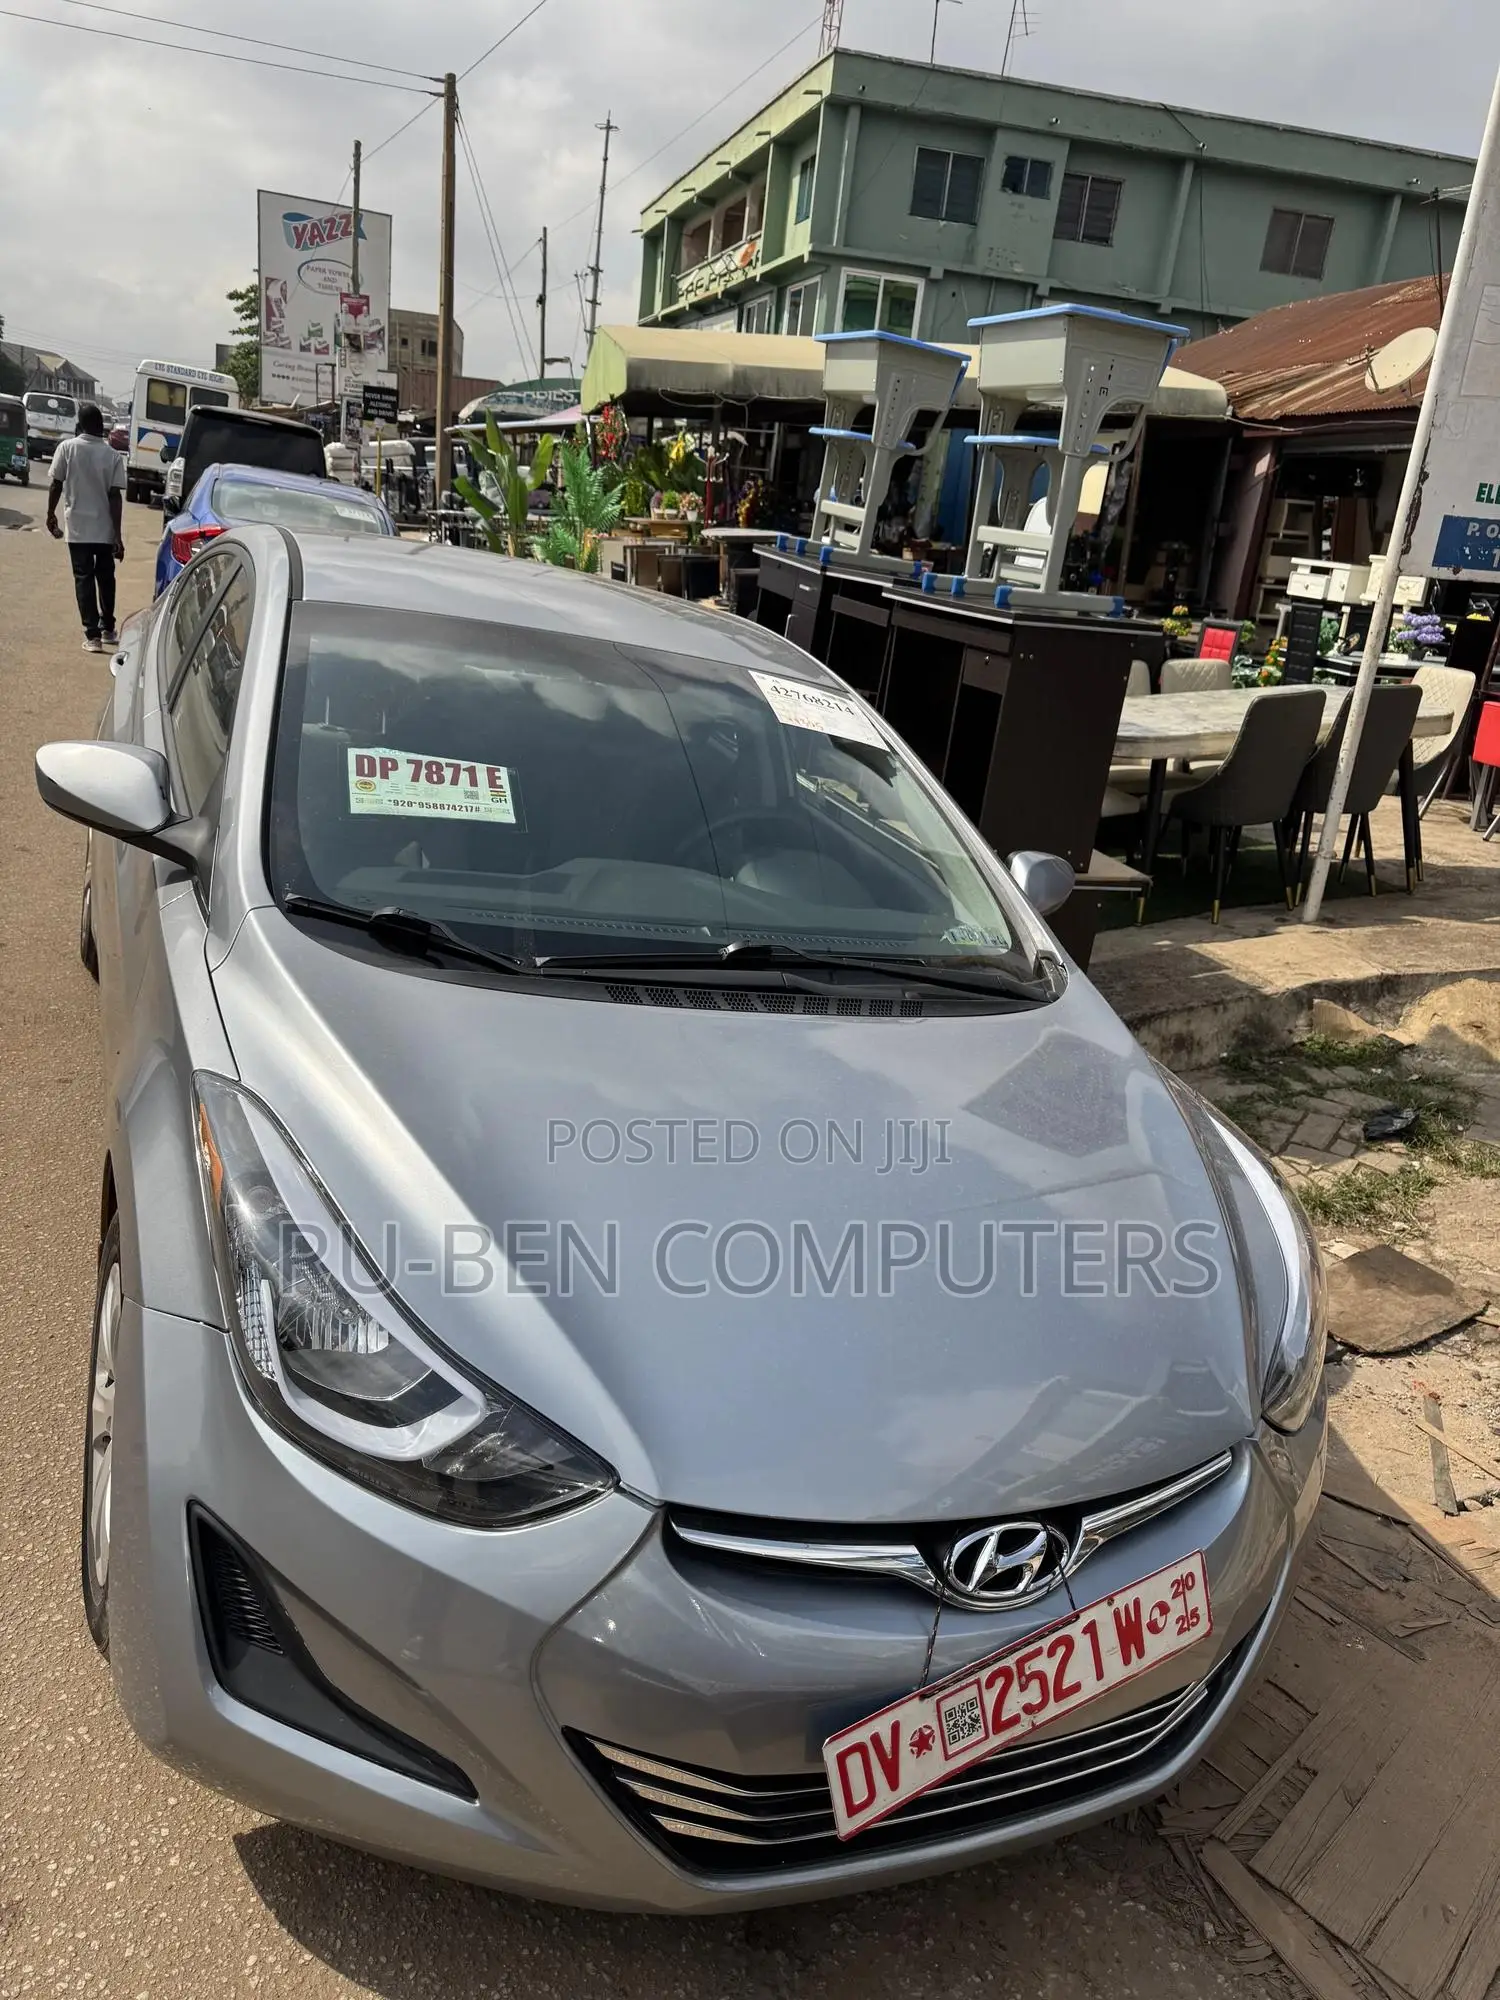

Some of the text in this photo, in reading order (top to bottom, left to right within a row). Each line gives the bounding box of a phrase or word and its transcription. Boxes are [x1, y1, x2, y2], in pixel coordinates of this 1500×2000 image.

[166, 364, 197, 378] STANDARD
[1476, 482, 1500, 505] EL
[355, 754, 504, 790] DP 7871 E
[836, 1597, 1145, 1818] DV 2521 W
